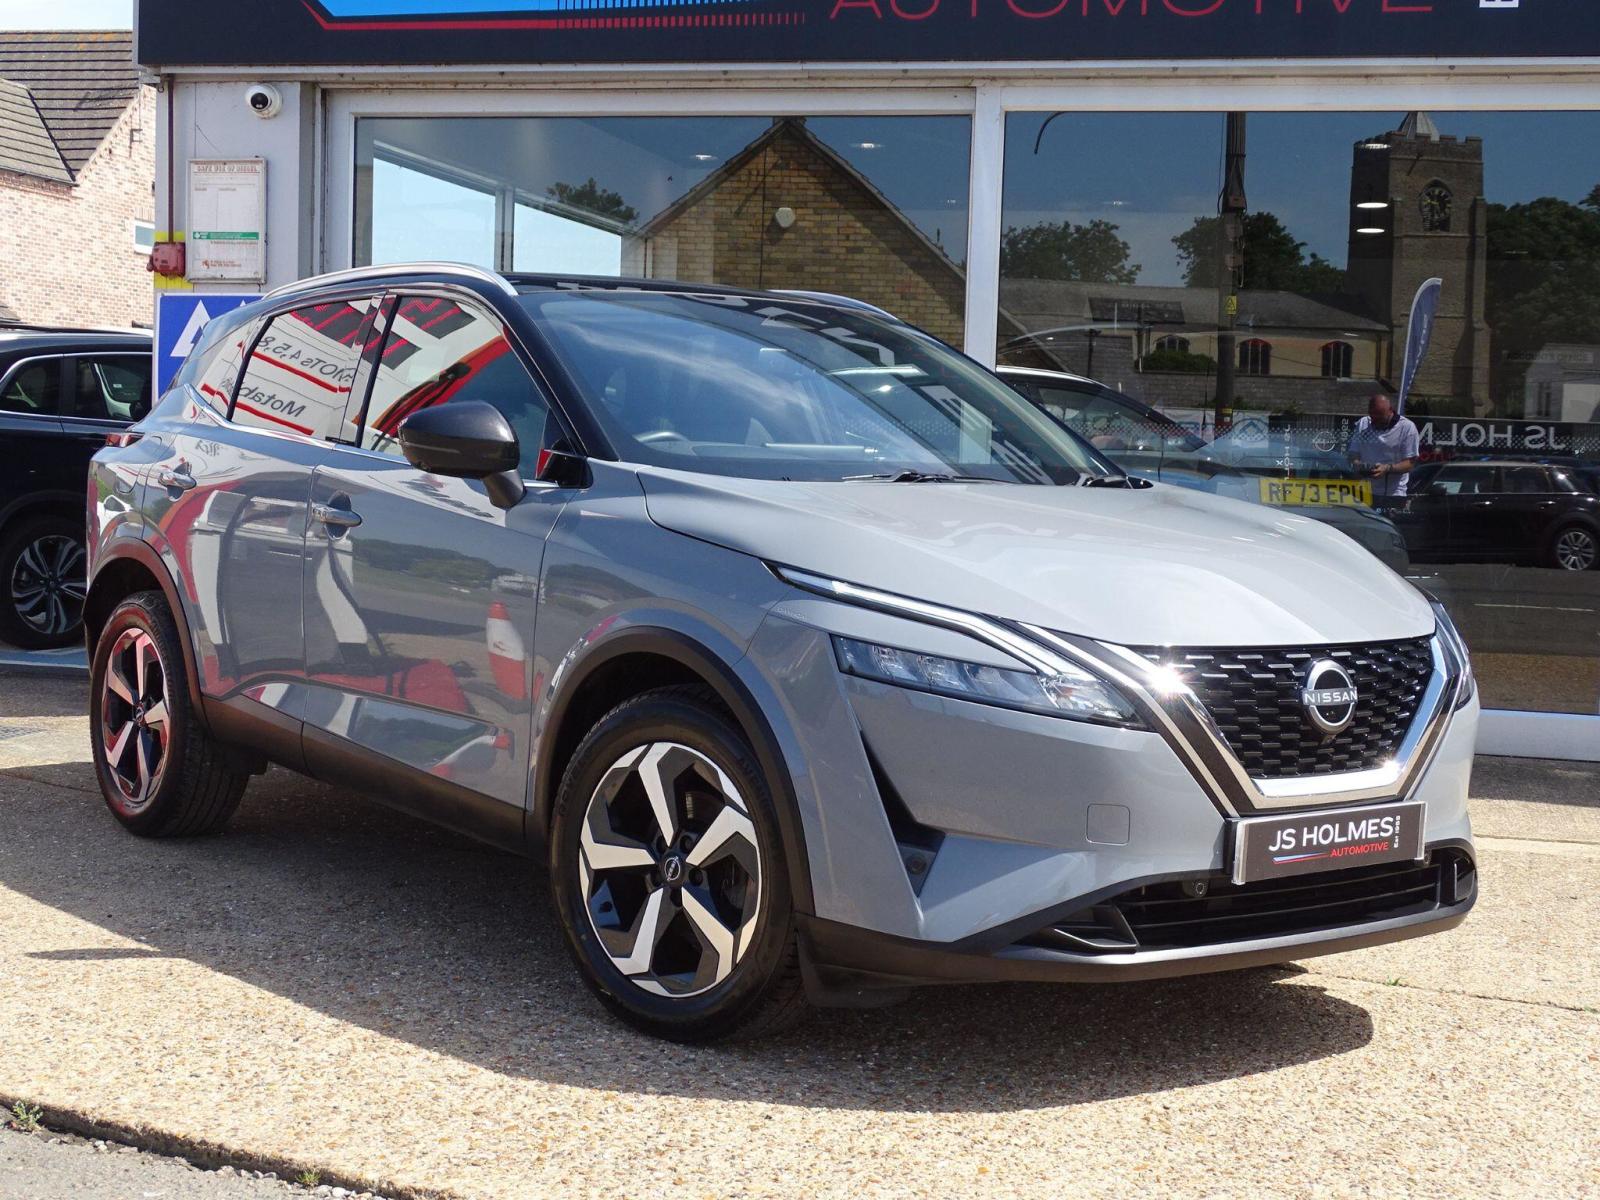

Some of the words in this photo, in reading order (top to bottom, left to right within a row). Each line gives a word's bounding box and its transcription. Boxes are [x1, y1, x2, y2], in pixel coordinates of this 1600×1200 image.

[1267, 482, 1320, 503] RF73
[1326, 484, 1364, 504] EPU
[1304, 690, 1358, 703] NISSAN
[1268, 828, 1296, 851] JS
[1302, 816, 1394, 847] HOLMES
[1330, 841, 1389, 858] AUTOMOTIVE
